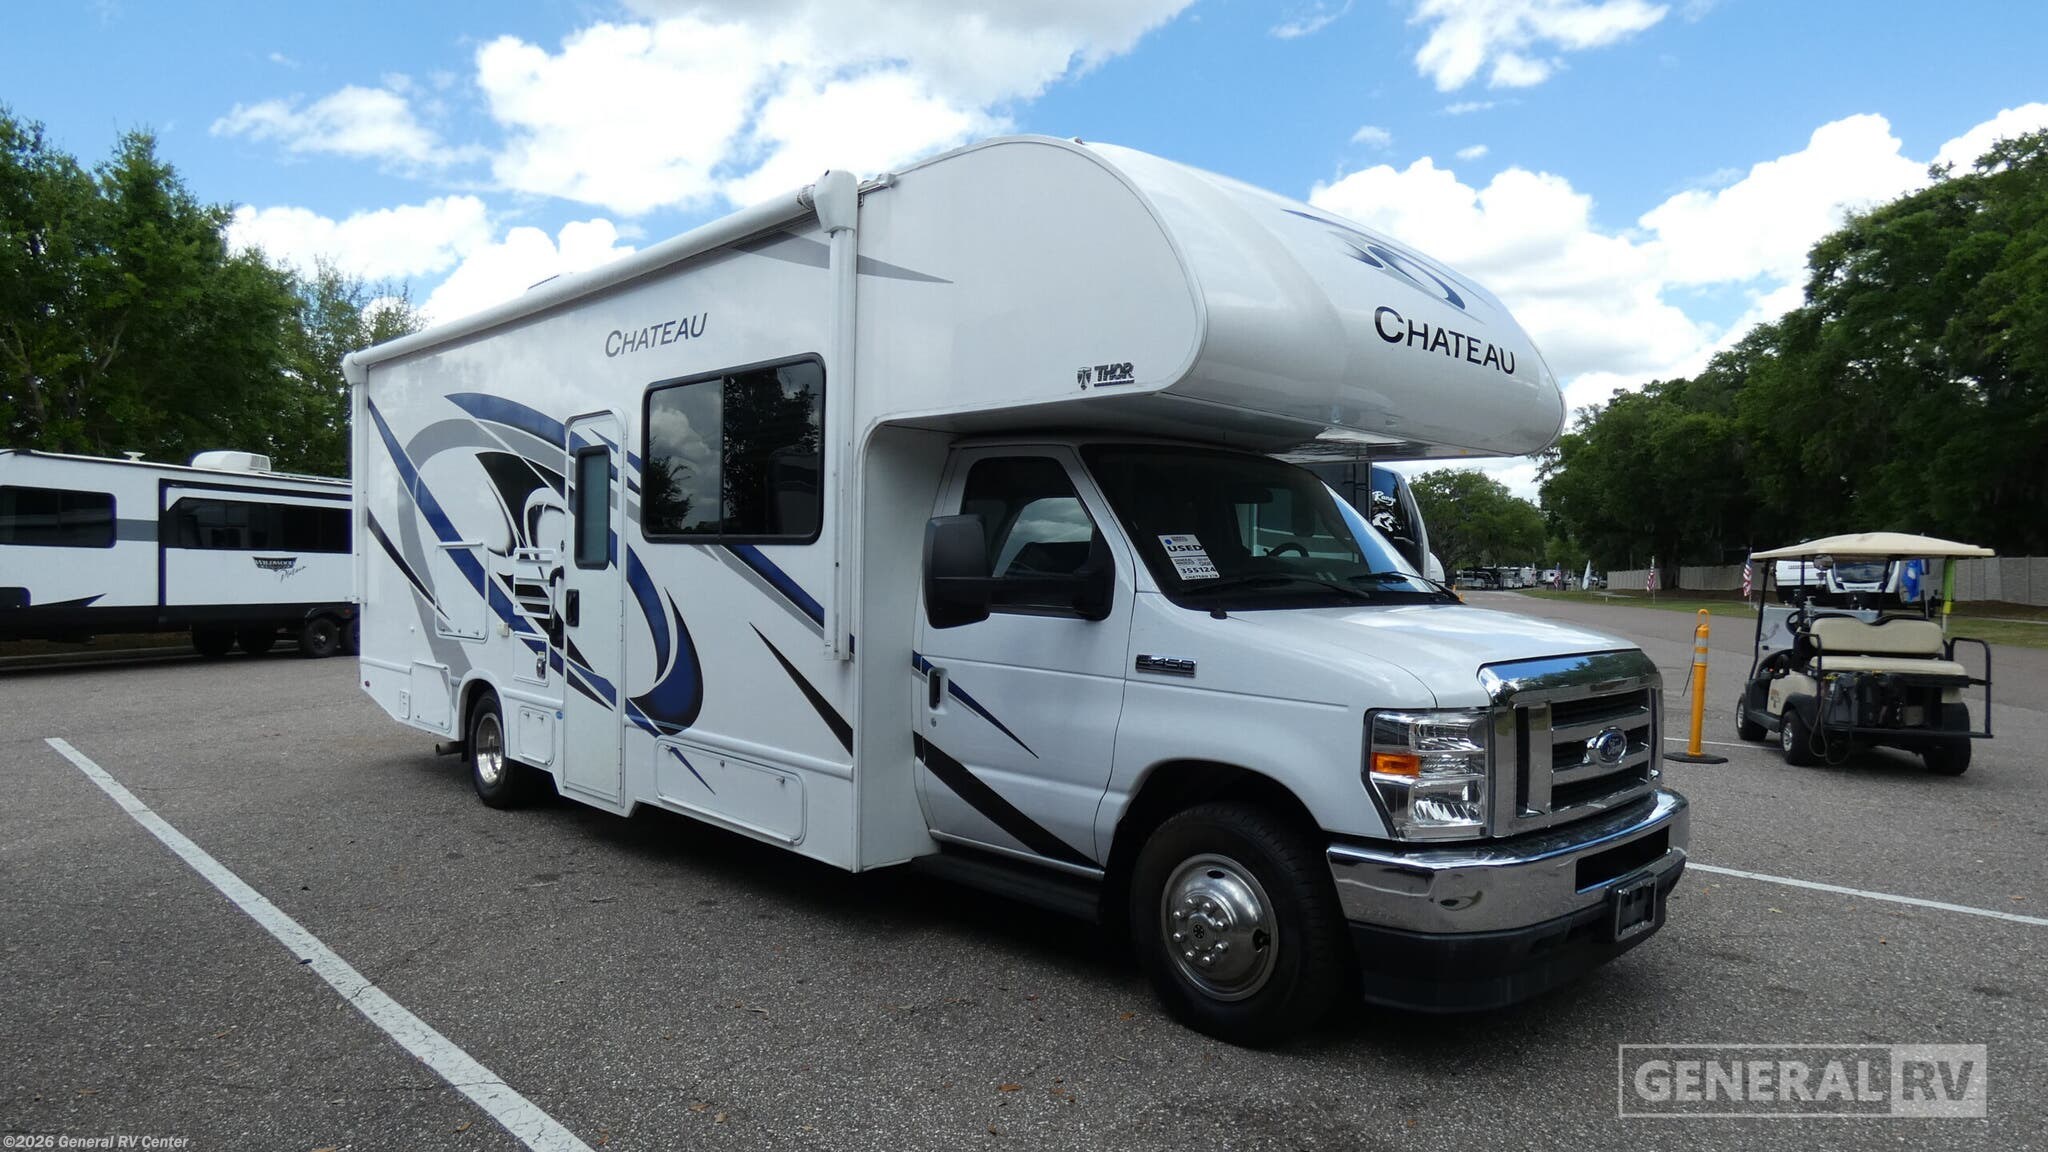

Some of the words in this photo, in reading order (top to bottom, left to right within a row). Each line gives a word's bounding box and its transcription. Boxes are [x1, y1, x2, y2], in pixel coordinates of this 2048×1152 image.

[604, 312, 708, 358] CHATEAU
[1374, 306, 1516, 375] CHATEAU
[1094, 362, 1135, 382] THOR
[1166, 544, 1203, 553] USED
